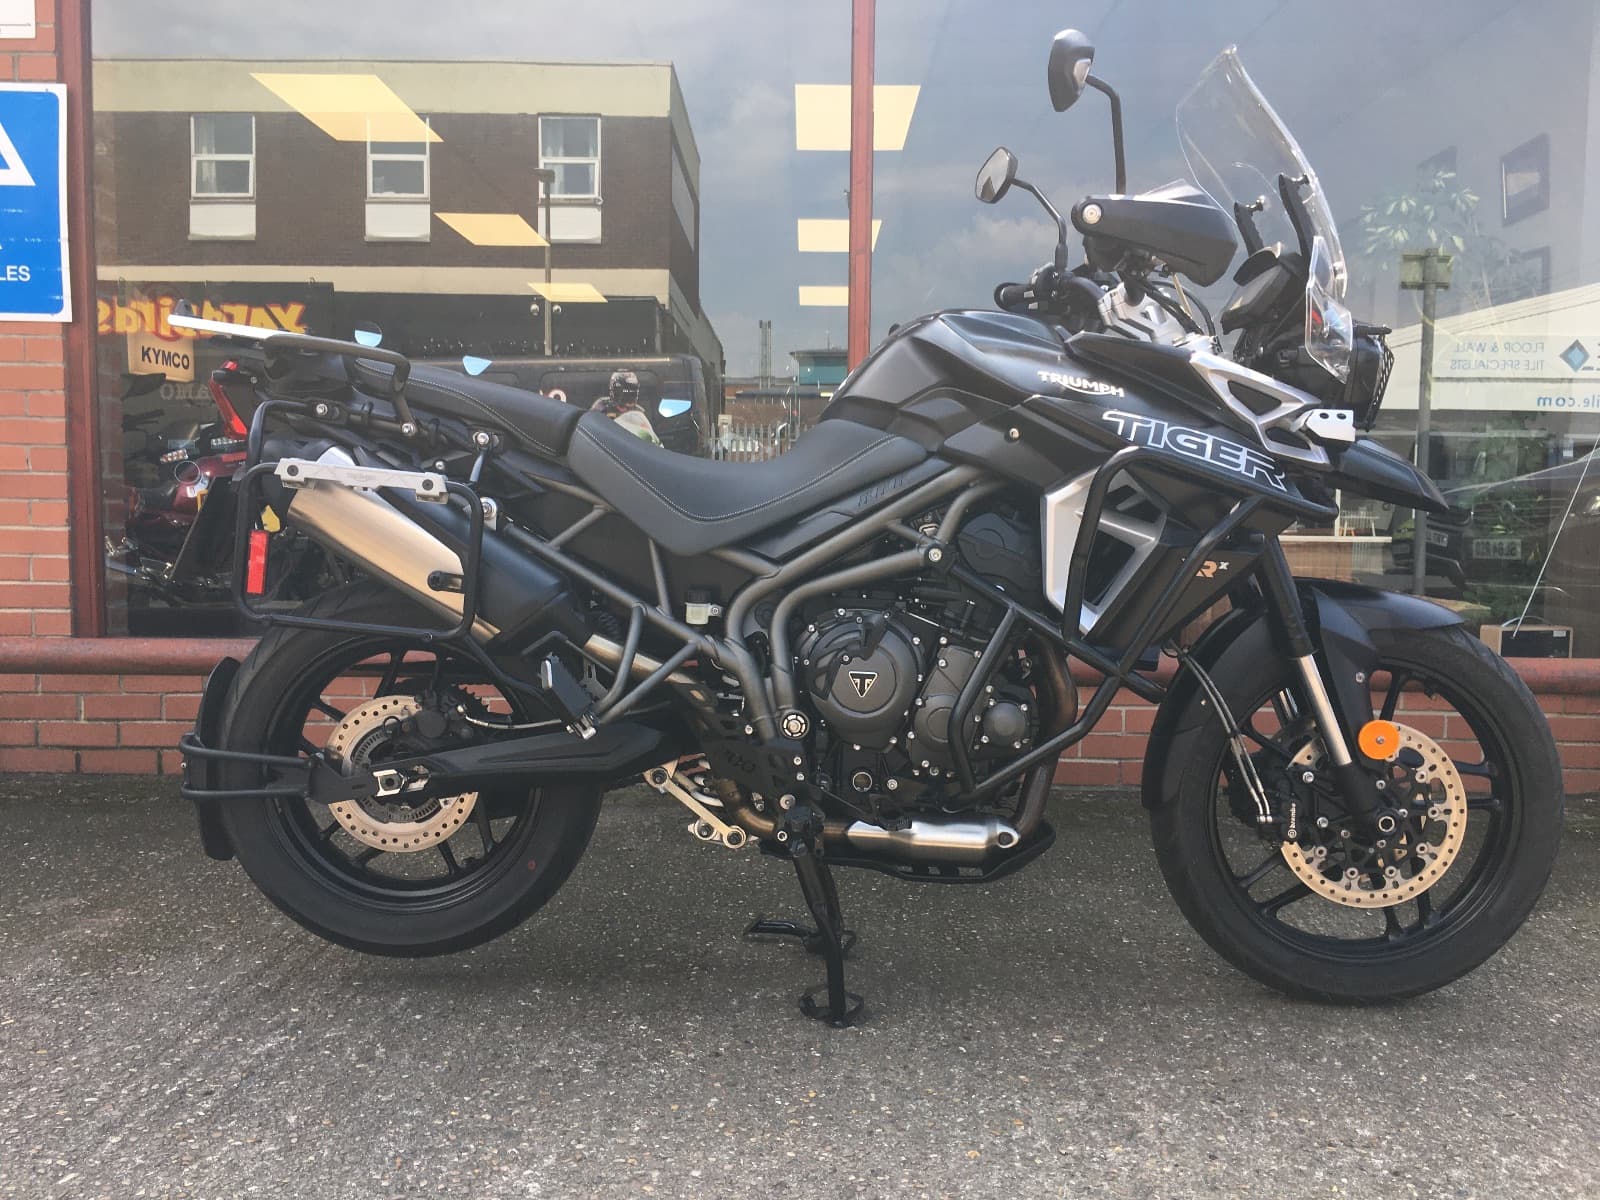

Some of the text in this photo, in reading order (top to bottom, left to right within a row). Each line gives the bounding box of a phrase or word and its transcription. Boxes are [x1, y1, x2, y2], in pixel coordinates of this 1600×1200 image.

[141, 345, 190, 370] KYMCO
[1037, 370, 1124, 397] TRIUMPH
[1102, 410, 1287, 492] TIGER
